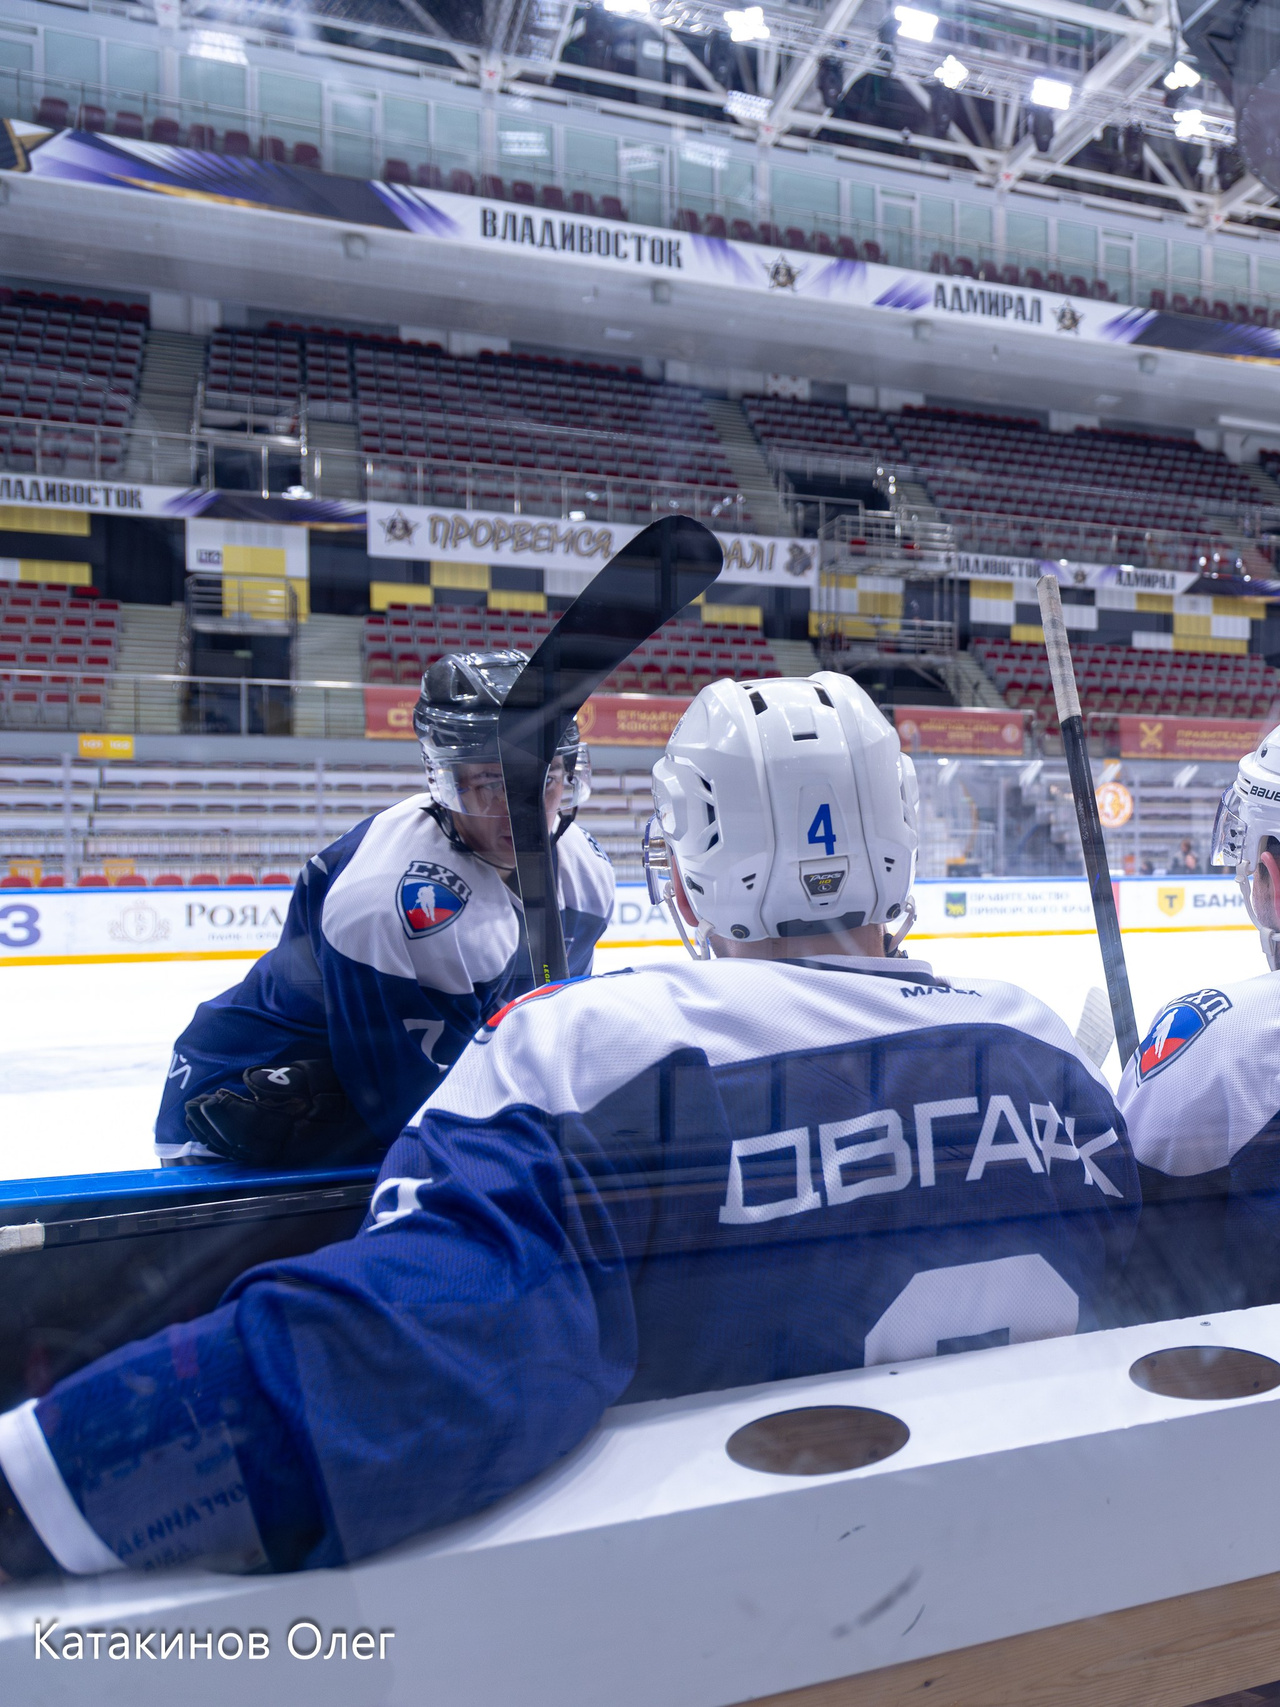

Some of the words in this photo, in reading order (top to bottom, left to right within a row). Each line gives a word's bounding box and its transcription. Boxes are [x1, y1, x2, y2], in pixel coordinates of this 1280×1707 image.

[480, 206, 684, 268] ВЛАДИВОСТОК
[933, 282, 1042, 324] АДМИРАЛ
[1115, 571, 1177, 589] АДМИРАЛ
[807, 803, 837, 856] 4
[809, 872, 842, 882] TACKS
[0, 904, 41, 947] 3
[611, 903, 668, 925] DA
